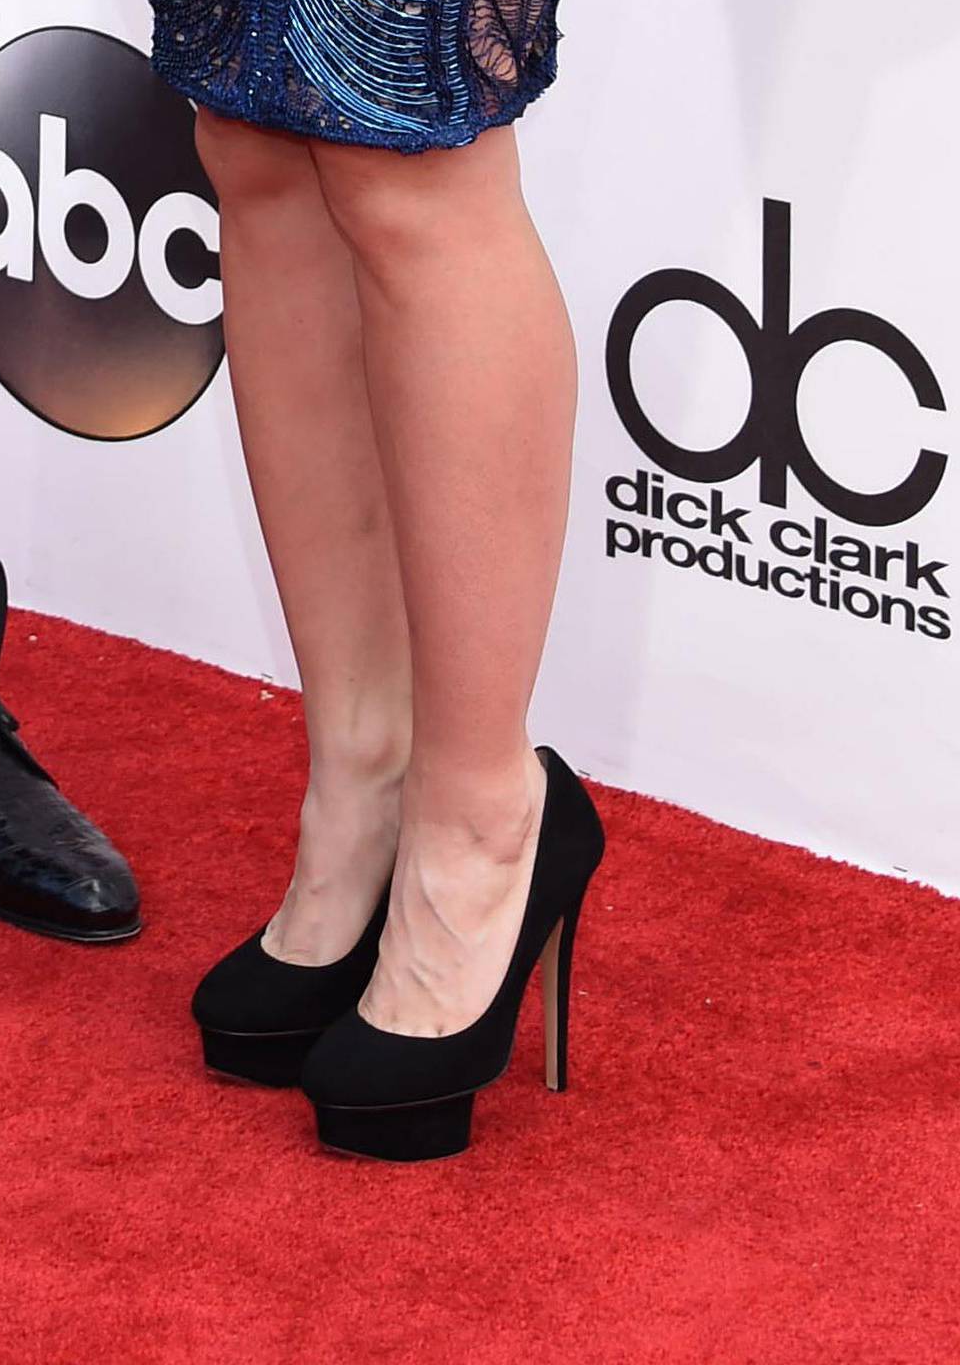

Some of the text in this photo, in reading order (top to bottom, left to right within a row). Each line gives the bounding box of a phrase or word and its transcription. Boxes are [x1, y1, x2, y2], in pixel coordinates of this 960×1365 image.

[605, 469, 951, 599] dick clark
[606, 518, 951, 640] productions
